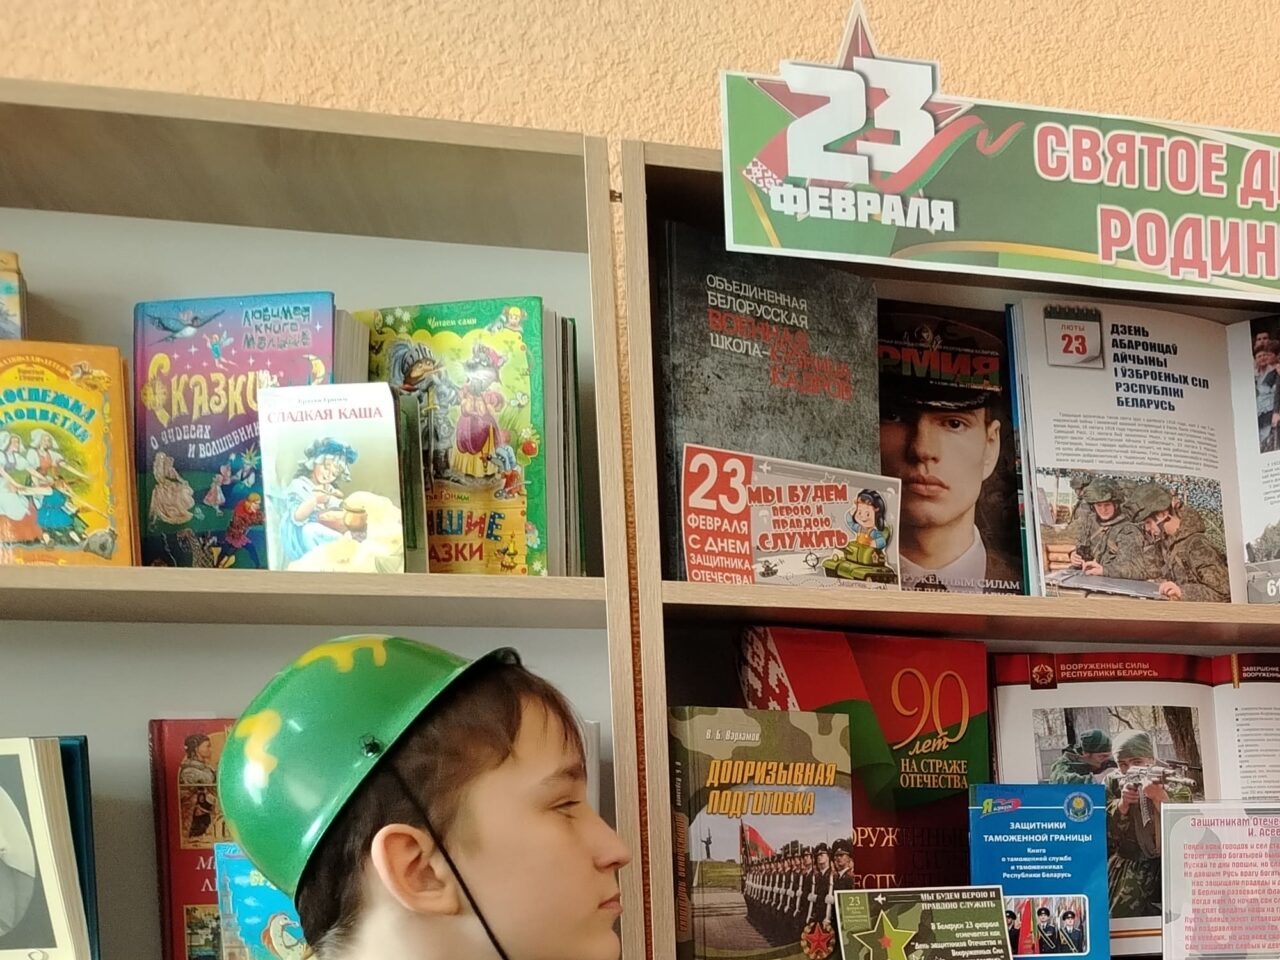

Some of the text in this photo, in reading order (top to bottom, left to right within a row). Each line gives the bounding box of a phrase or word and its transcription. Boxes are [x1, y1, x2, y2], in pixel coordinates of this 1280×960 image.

[780, 56, 938, 184] 23
[1034, 123, 1227, 197] СВЯТОЕ
[770, 184, 956, 235] ФЕВРАЛЯ
[706, 274, 808, 311] ОБЪЕДИНЕННАЯ
[707, 290, 808, 329] БЕЛОРУССКАЯ
[428, 317, 477, 328] Читаем сами
[1110, 323, 1150, 338] ДЗЕНЬ
[1061, 334, 1087, 355] 23
[1112, 338, 1178, 356] АБАРОНЦАЎ
[878, 345, 1000, 385] РМИЯ
[1112, 352, 1168, 368] АЙЧЫНЫ
[1119, 365, 1209, 390] ЎЗБРОЕНЫХ СІЛ
[1115, 382, 1184, 399] РЭСПУБЛІКІ
[1116, 396, 1176, 412] БЕЛАРУСЬ
[268, 406, 383, 423] СЛАДКАЯ КАША
[688, 453, 747, 514] 23
[747, 484, 848, 504] МЫ БУДЕМ
[687, 513, 748, 534] ФЕВРАЛЯ
[688, 535, 750, 555] С ДНЕМ
[758, 530, 848, 551] СЛУЖИТЬ
[428, 543, 484, 563] АЗКИ
[690, 553, 750, 571] ЗАЩИТНИКА
[978, 578, 1020, 590] СИЛАМ
[1060, 662, 1149, 671] ВООРУЖЕННЫЕ СИЛЫ
[1060, 669, 1158, 678] РЕСПУБЛИКИ БЕЛАРУСЬ
[891, 668, 971, 750] 90
[909, 731, 951, 756] лет
[706, 760, 837, 787] ДОПРИЗЫВНАЯ
[901, 759, 968, 774] НА СТРАЖЕ
[900, 773, 968, 789] ОТЕЧЕСТВА
[706, 790, 815, 818] ПОДГОТОВКА
[1010, 822, 1066, 830] ЗАЩИТНИКИ
[1191, 818, 1250, 828] Защитникам
[984, 834, 1092, 843] ТАМОЖЕННОЙ ГРАНИЦЫ
[849, 897, 861, 906] 23
[922, 901, 995, 910] ПРАВДОЮ СЛУЖИТЬ
